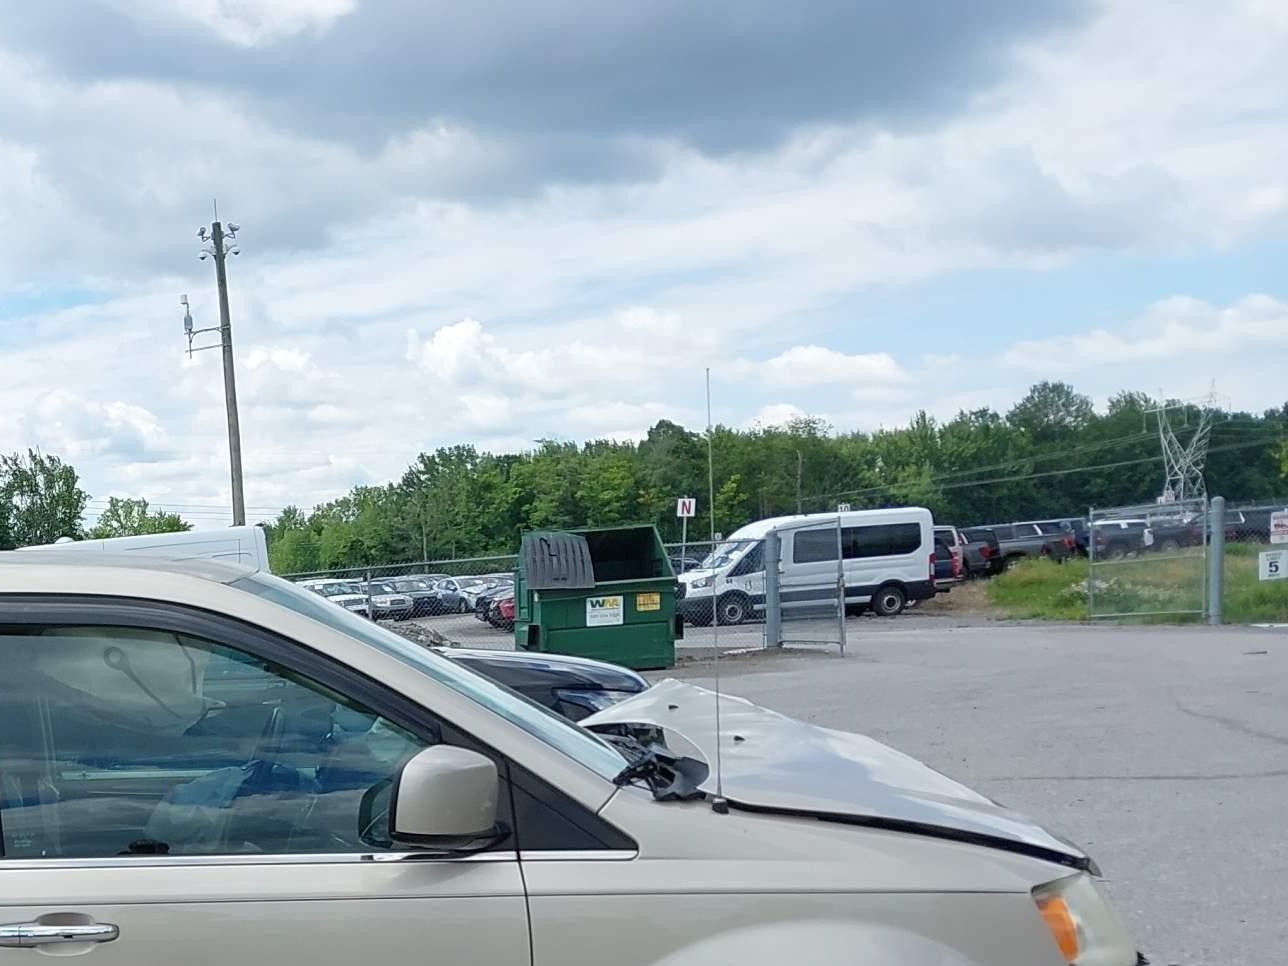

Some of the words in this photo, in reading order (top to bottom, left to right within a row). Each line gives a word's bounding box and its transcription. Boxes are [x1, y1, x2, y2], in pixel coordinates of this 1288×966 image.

[682, 500, 691, 515] N
[1268, 560, 1279, 573] 5
[590, 599, 619, 608] WM
